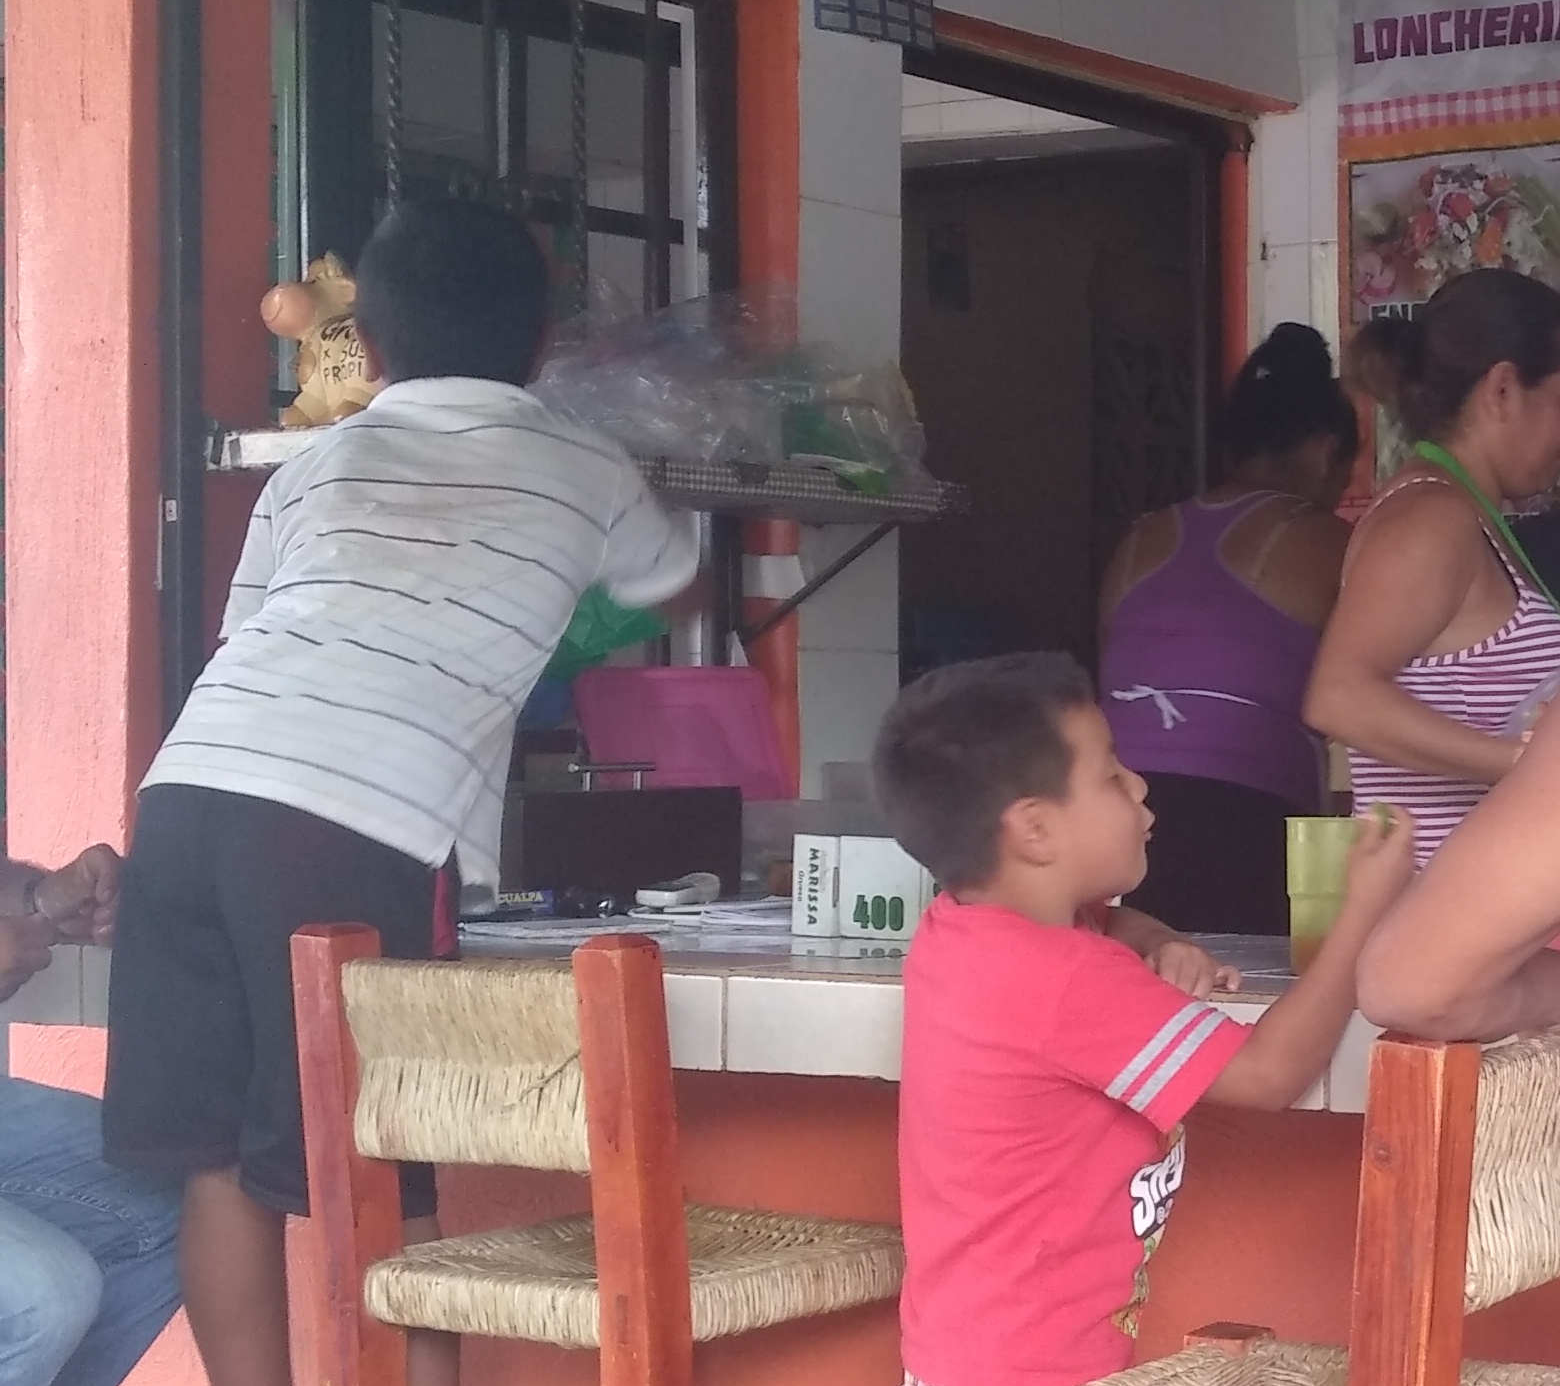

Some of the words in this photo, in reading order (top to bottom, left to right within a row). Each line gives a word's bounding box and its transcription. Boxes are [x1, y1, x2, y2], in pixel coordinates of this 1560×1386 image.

[323, 361, 362, 386] PROPI
[807, 847, 820, 926] MARISSA
[853, 894, 904, 932] 400
